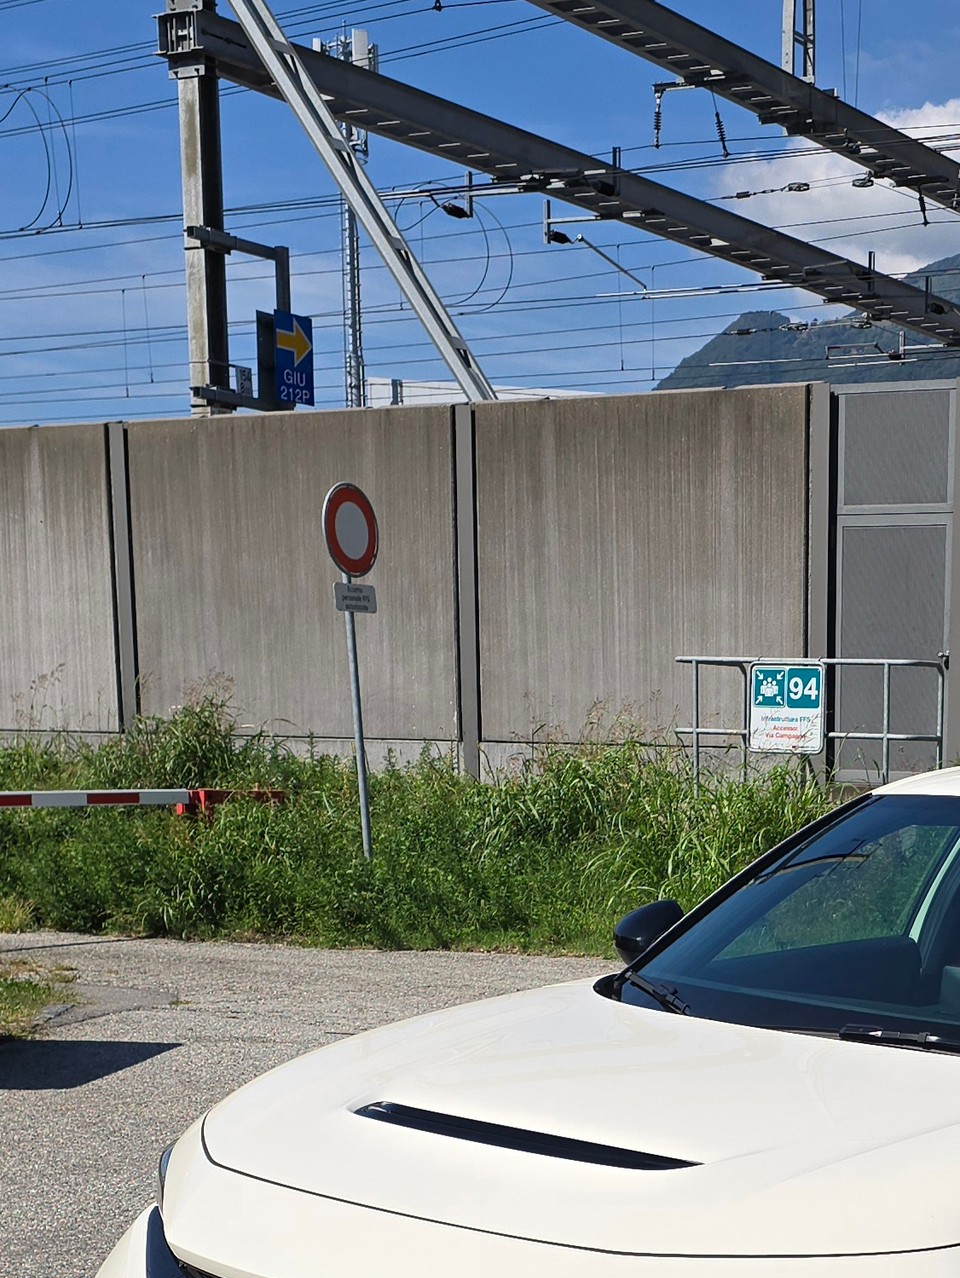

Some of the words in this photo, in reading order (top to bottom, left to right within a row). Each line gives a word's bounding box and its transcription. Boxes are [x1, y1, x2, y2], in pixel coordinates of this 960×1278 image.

[283, 369, 306, 387] GIU
[280, 385, 310, 403] 212P
[788, 676, 819, 700] 94
